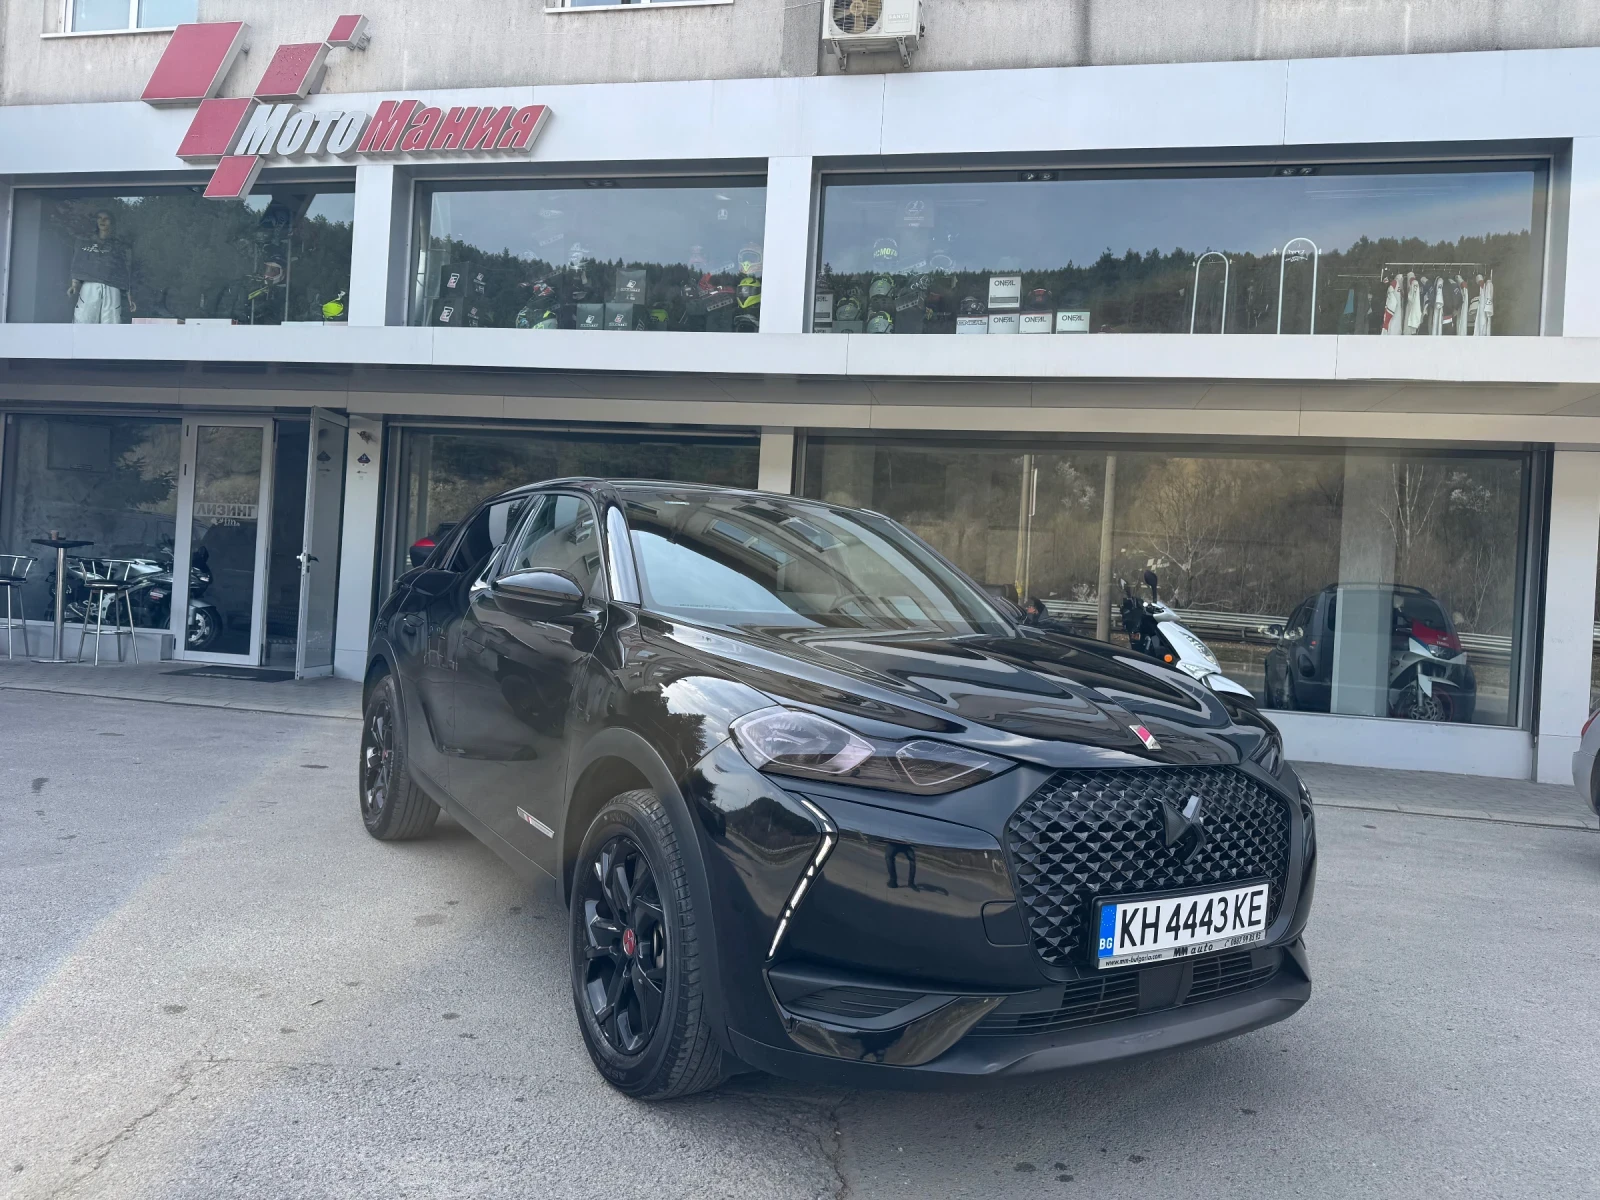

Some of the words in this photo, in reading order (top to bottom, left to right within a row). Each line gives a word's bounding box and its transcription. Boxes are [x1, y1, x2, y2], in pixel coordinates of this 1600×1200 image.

[233, 99, 550, 156] МотоМания
[196, 503, 256, 517] ЛИЗИНГ
[1119, 905, 1161, 949] KH
[1165, 896, 1229, 942] 4443
[1232, 889, 1264, 930] KE
[1099, 937, 1113, 950] BG
[1190, 943, 1214, 955] auto
